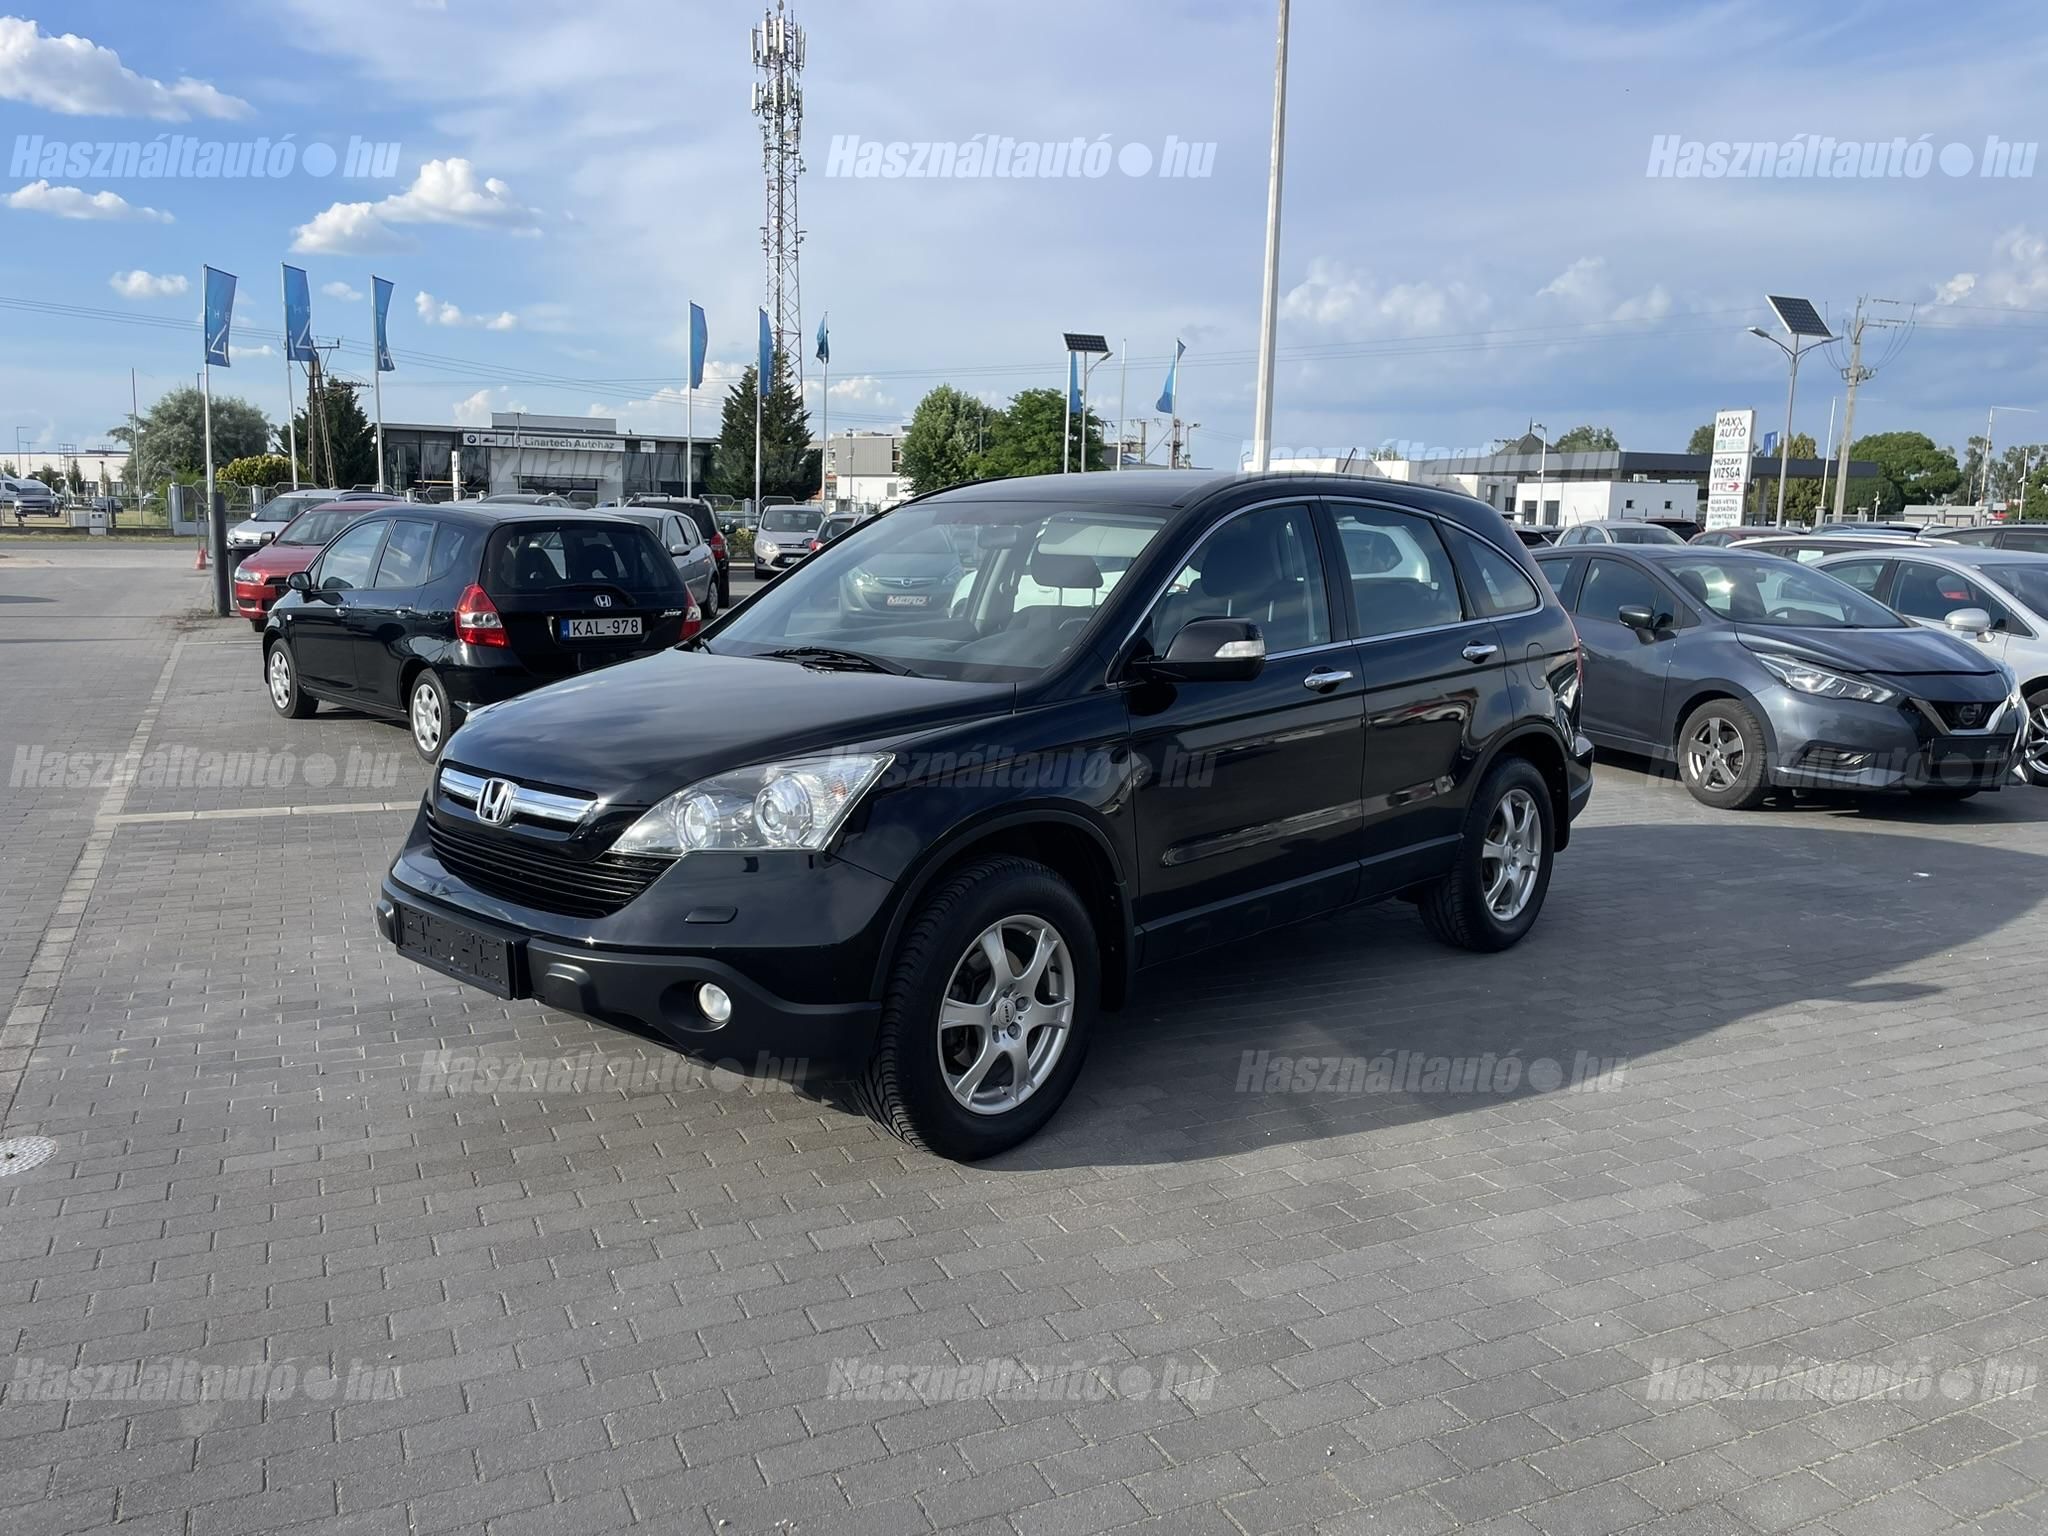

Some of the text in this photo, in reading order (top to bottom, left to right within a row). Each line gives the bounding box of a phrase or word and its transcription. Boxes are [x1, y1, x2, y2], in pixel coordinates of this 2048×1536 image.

[524, 438, 572, 448] Linartech
[1713, 467, 1741, 478] VIZSGA
[572, 619, 639, 636] KAL-978
